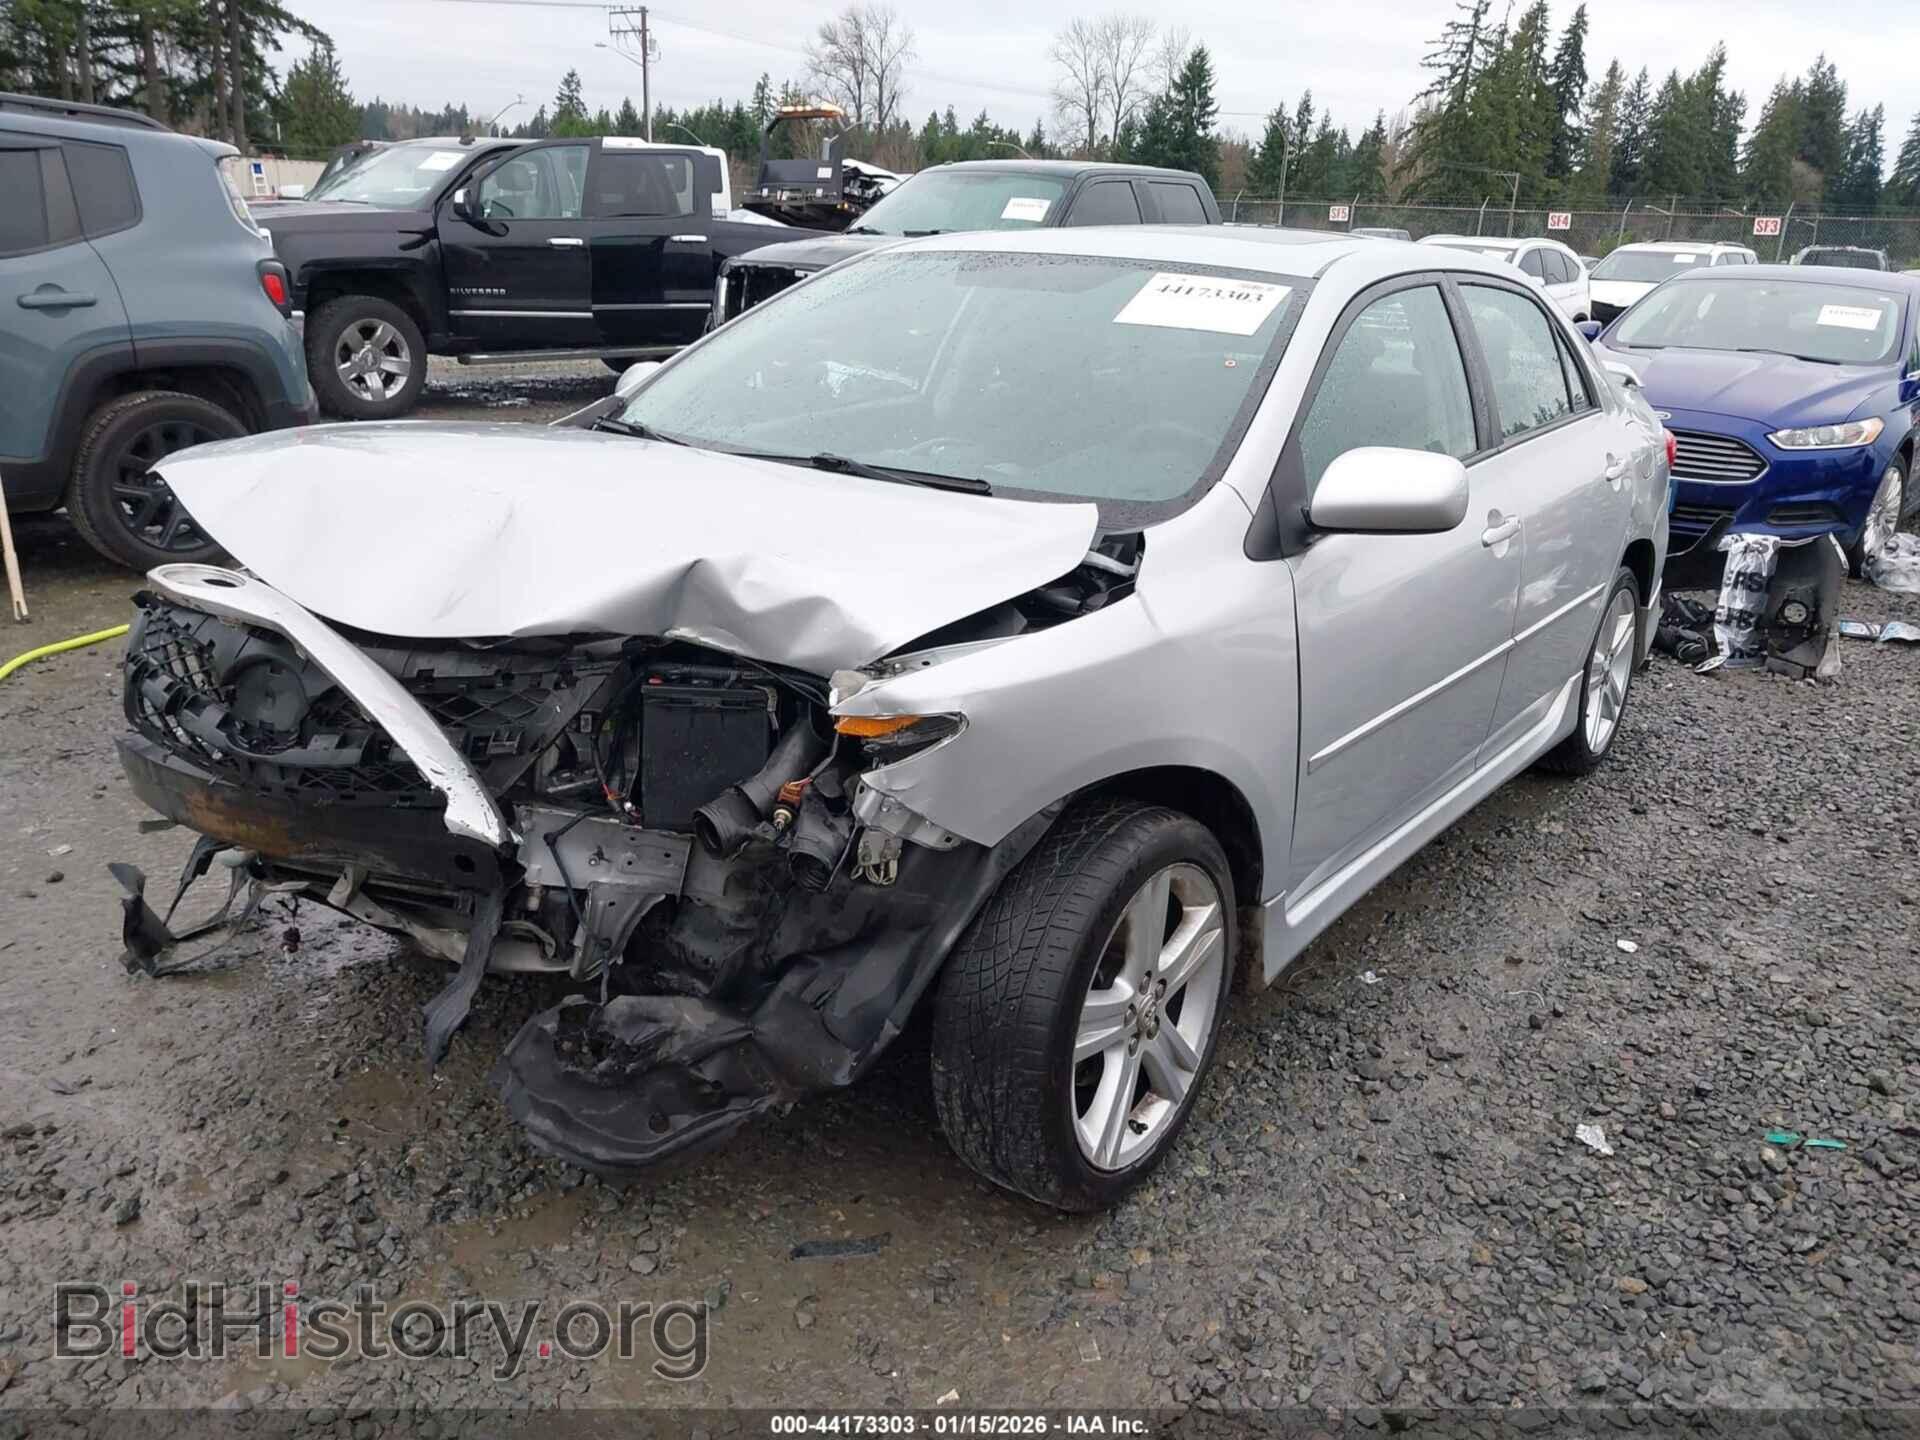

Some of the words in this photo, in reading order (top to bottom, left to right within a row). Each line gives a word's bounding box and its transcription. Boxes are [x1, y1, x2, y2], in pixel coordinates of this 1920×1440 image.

[1550, 214, 1569, 227] SF4
[1756, 219, 1779, 233] SF3
[1156, 283, 1265, 303] 44173303
